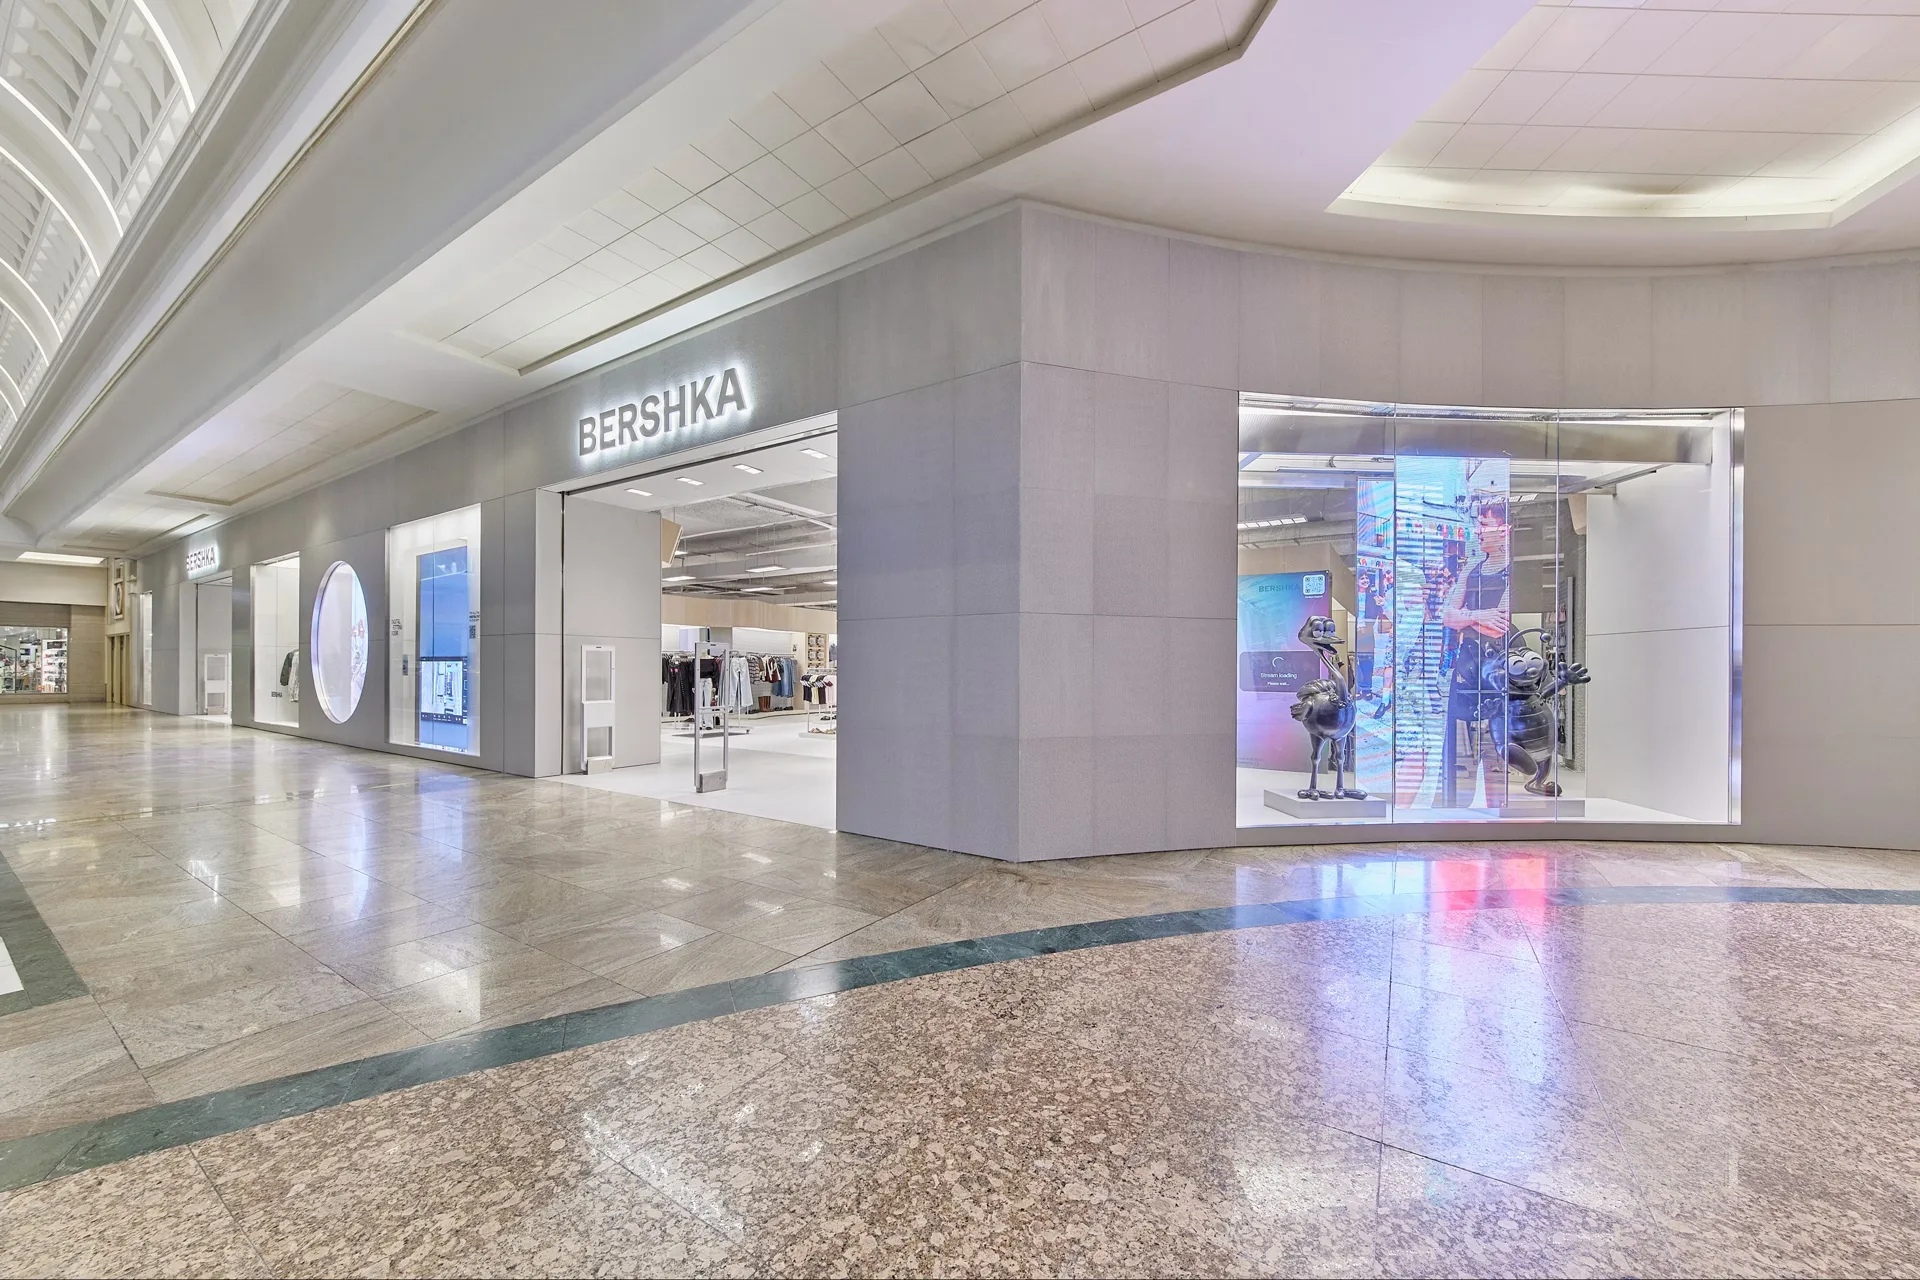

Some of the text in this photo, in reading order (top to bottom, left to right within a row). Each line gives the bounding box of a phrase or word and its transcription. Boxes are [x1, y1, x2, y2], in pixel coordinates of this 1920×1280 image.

[579, 367, 748, 456] BERSHKA
[186, 547, 216, 571] BERSHKA
[1258, 583, 1300, 593] BERSHKA
[1279, 672, 1298, 680] loading
